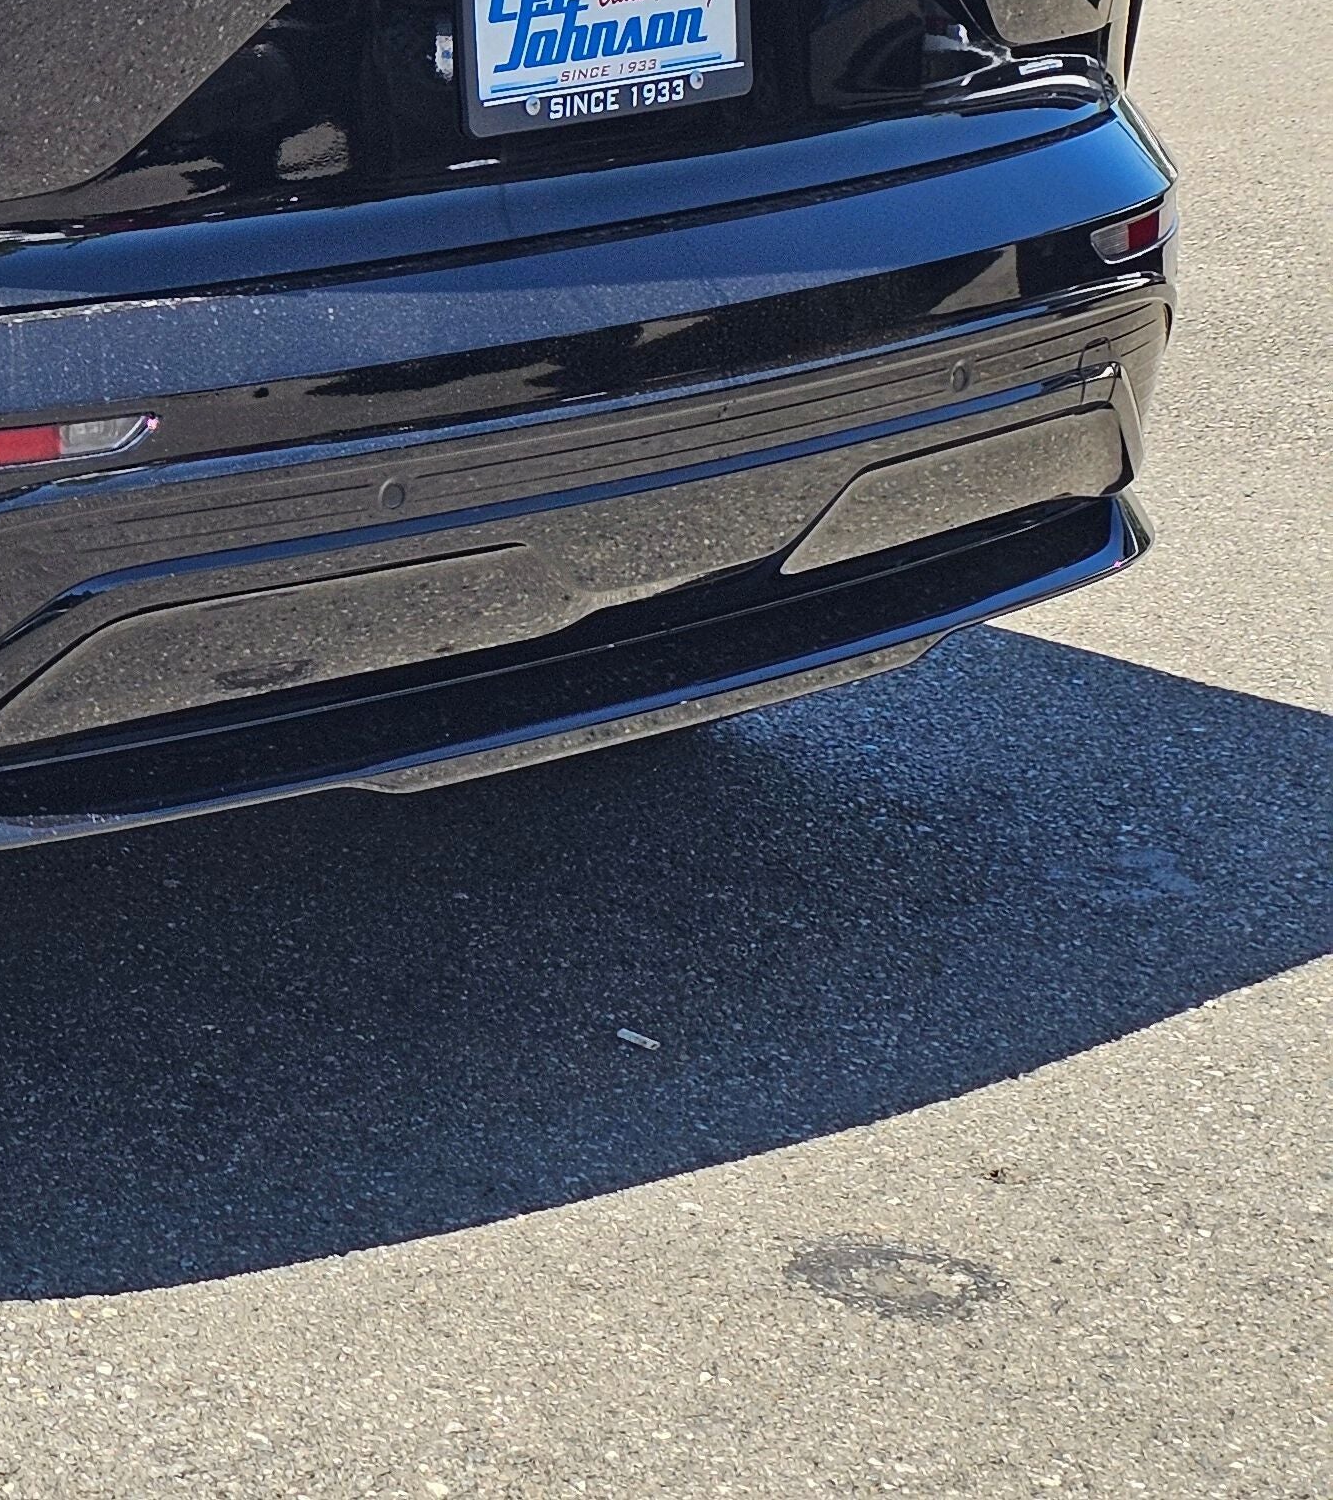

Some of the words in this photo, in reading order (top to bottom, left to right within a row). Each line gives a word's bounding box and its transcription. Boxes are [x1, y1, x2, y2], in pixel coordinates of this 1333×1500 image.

[493, 3, 707, 74] Johnson
[560, 65, 611, 83] SINCE
[619, 59, 657, 76] 1933
[549, 89, 620, 120] SINCE
[631, 79, 685, 108] 1933
